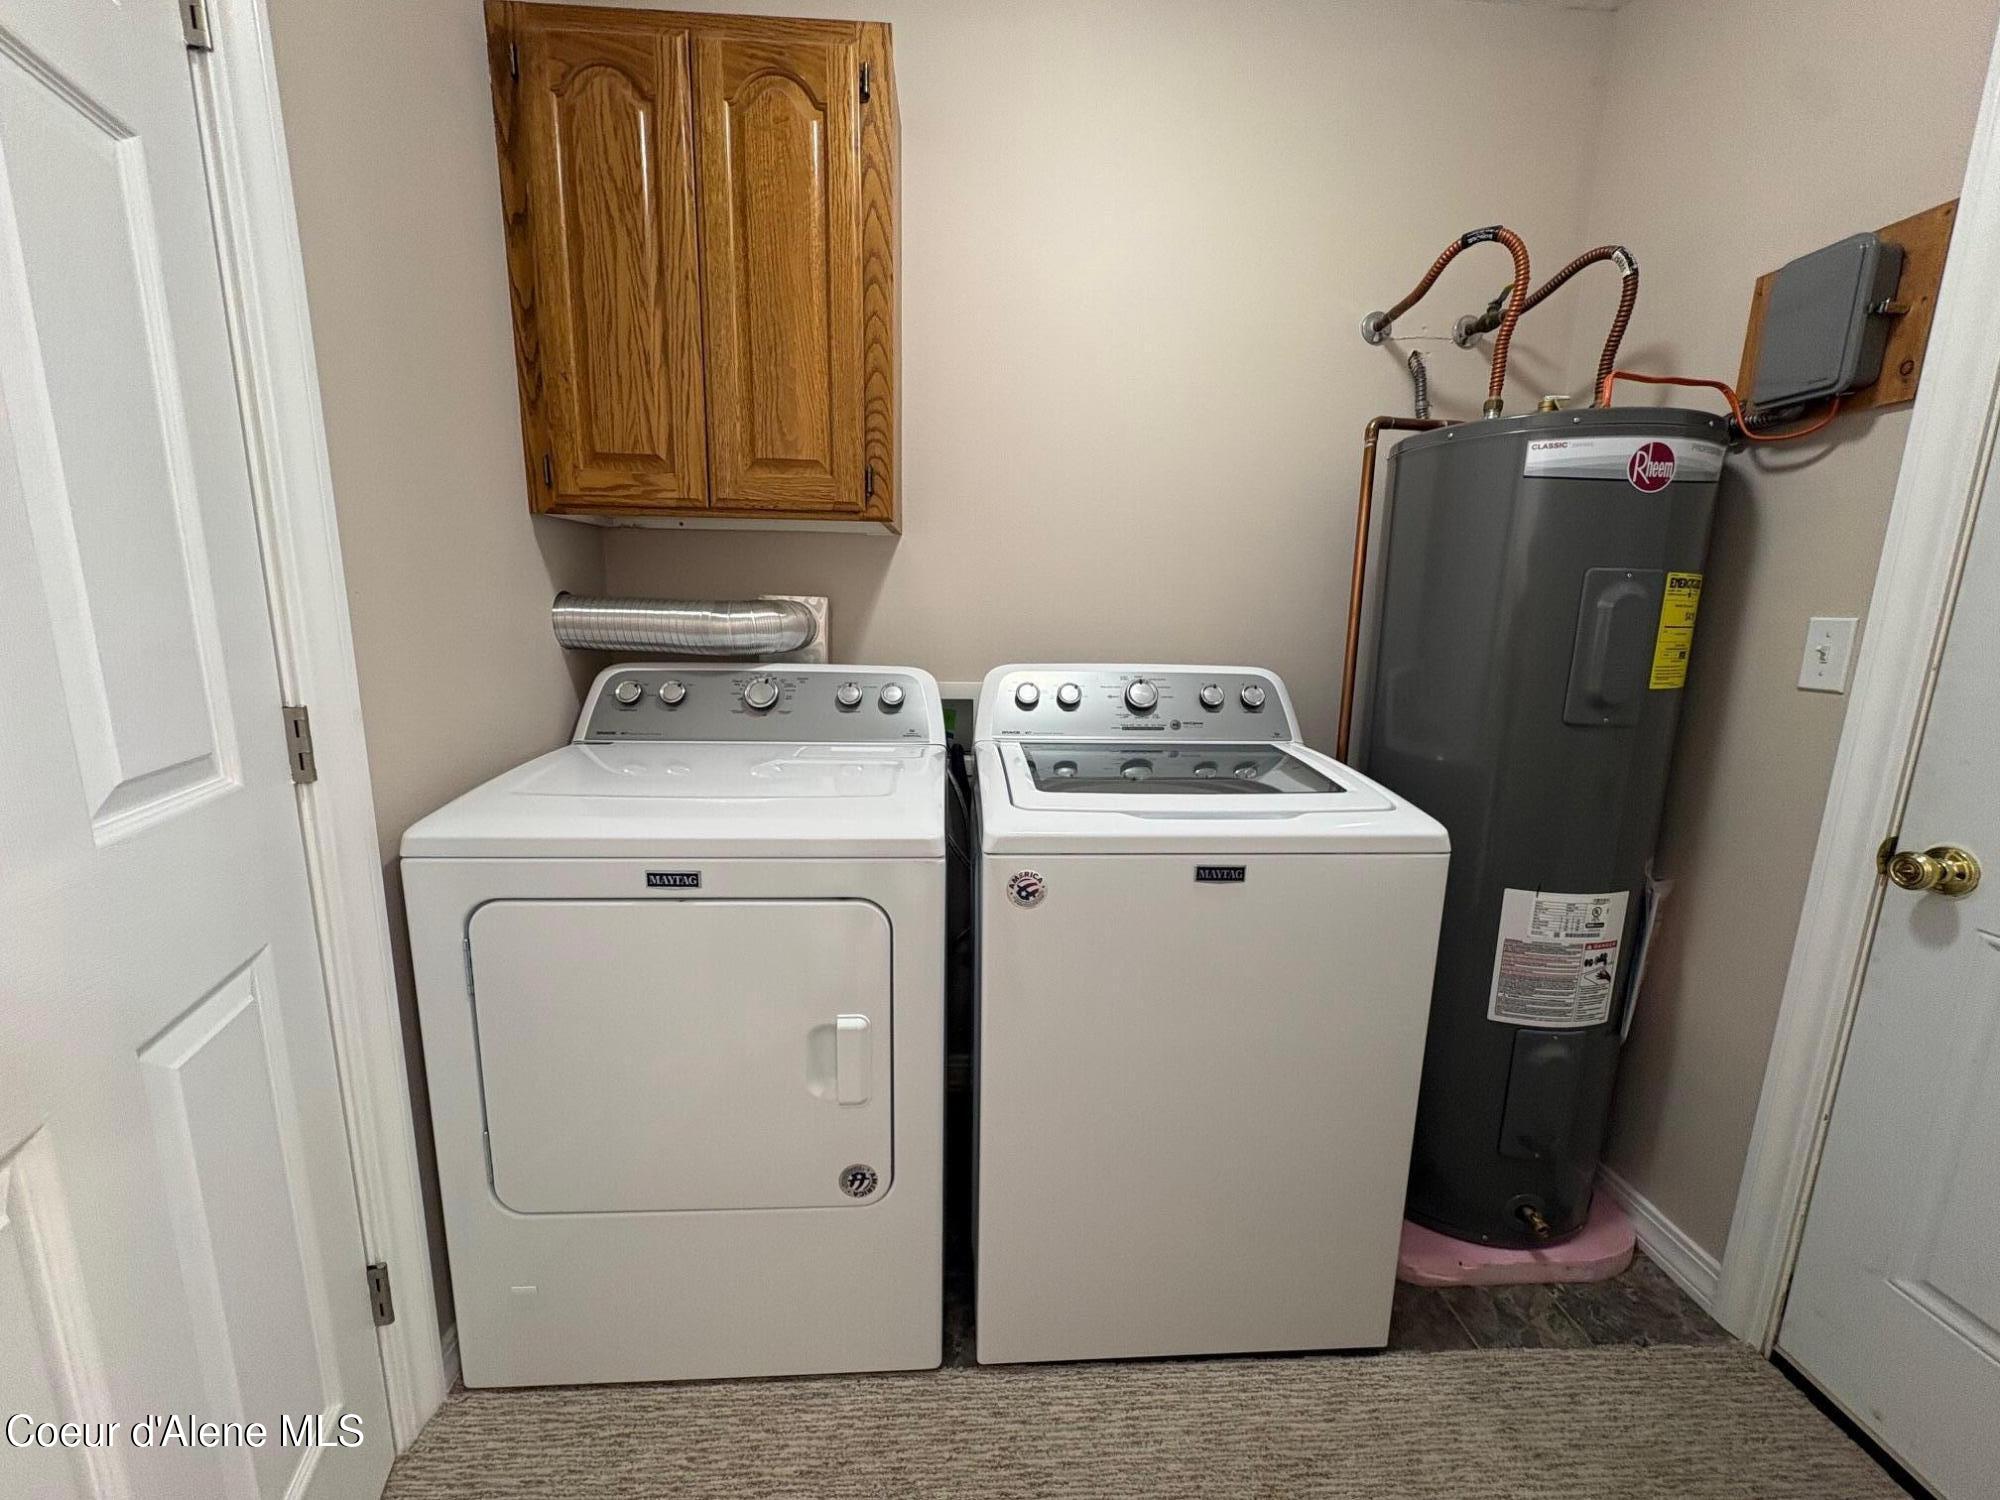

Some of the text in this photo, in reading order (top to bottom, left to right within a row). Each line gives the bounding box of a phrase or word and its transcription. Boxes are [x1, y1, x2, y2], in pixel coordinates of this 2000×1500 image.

[1531, 441, 1569, 450] CLASSIC
[1633, 441, 1674, 484] Rheem
[1199, 869, 1243, 879] MAYTAG
[649, 875, 697, 885] MAYTAG
[1009, 871, 1043, 889] AMERICA
